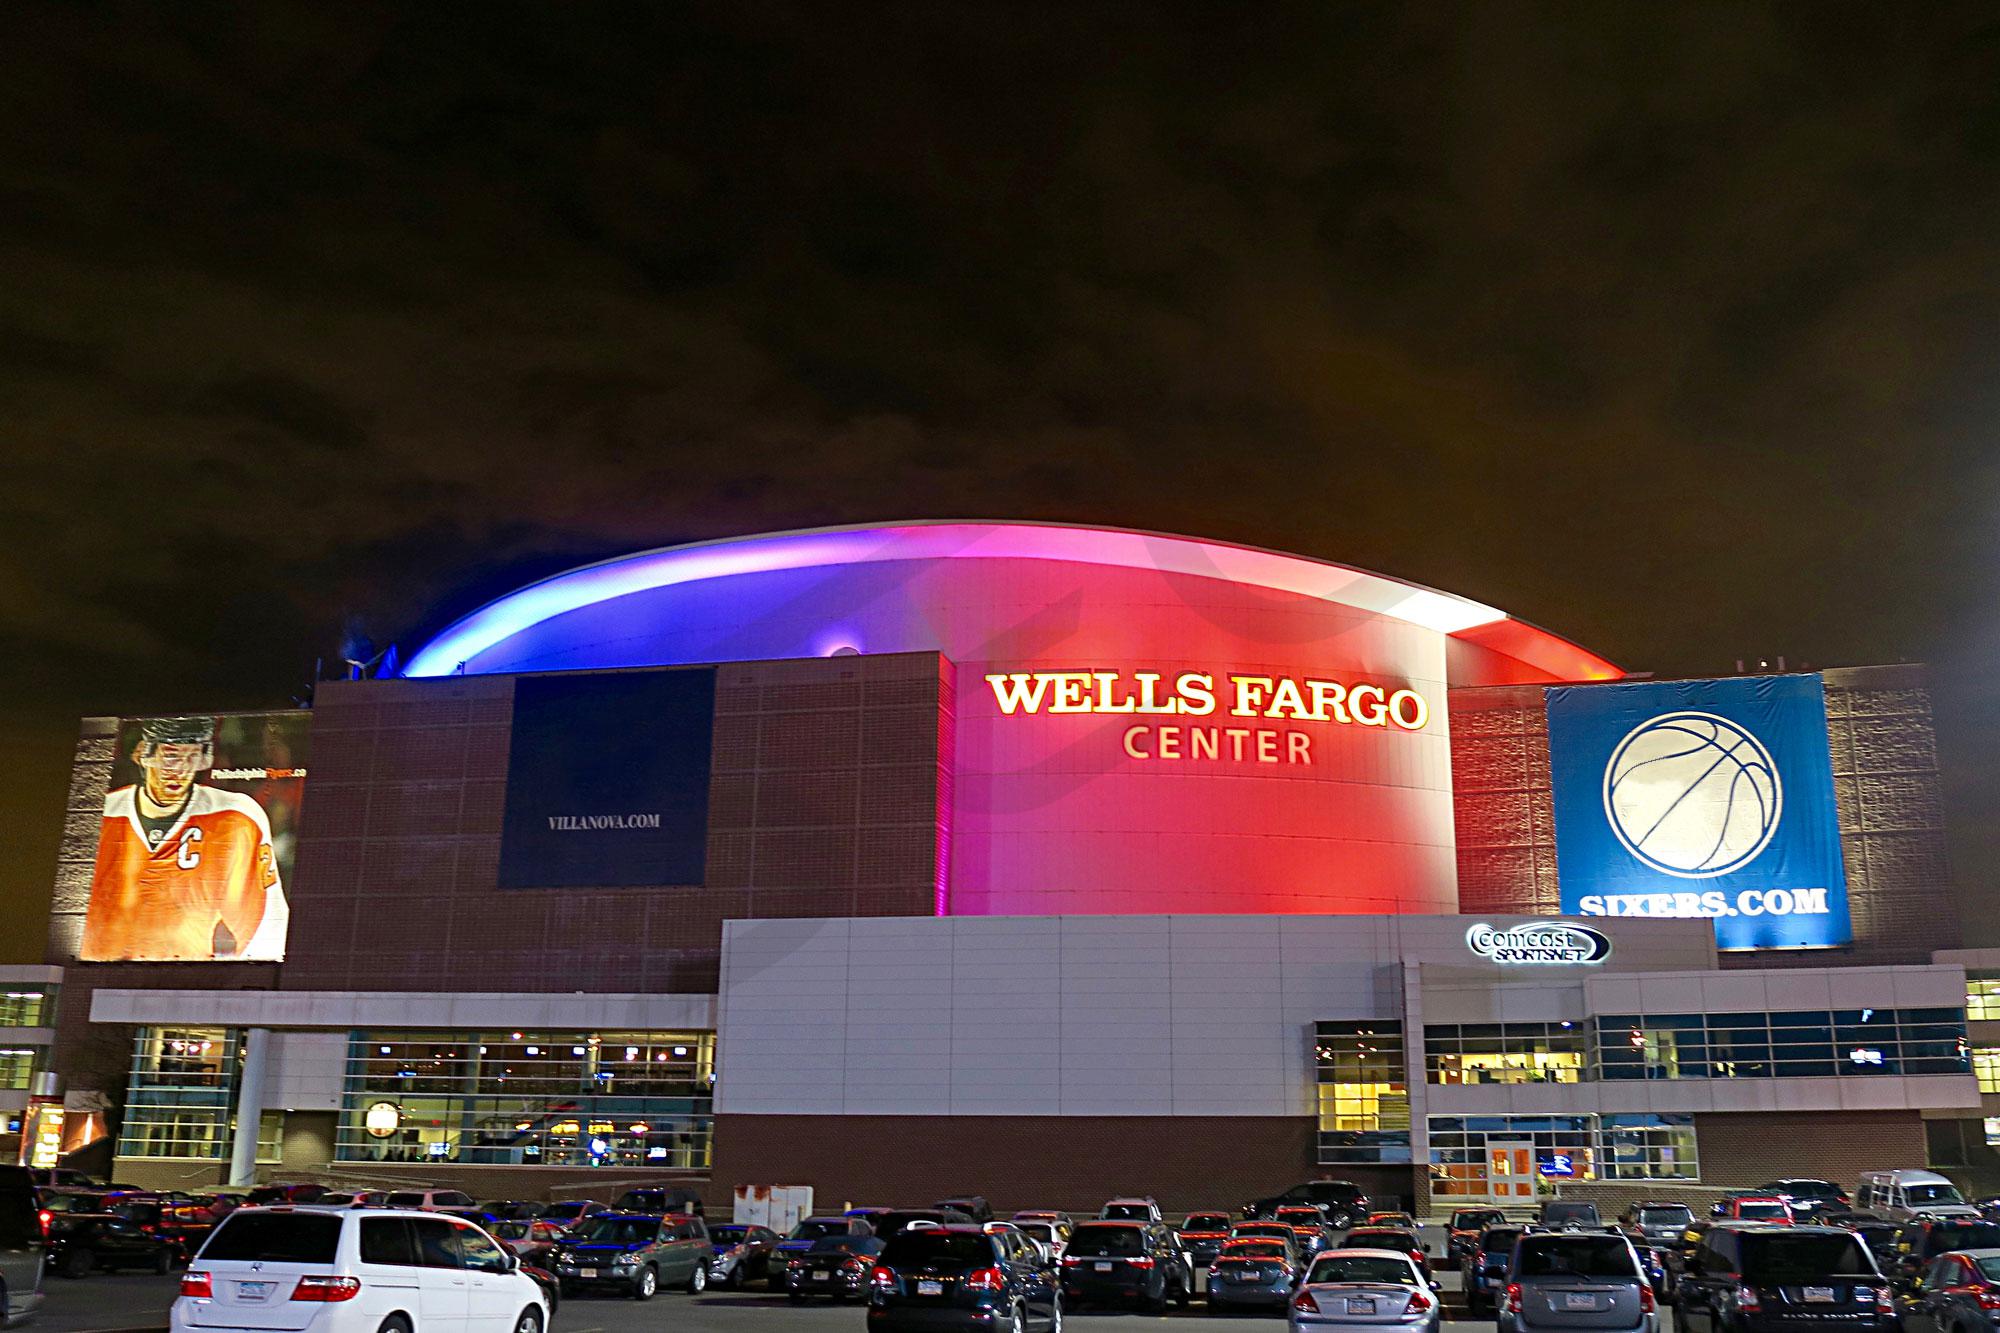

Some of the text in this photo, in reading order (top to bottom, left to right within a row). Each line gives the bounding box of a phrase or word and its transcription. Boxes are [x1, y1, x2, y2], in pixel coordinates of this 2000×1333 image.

[985, 672, 1430, 730] WELLS FARGO
[1123, 726, 1312, 765] CENTER
[548, 814, 661, 830] VILLANOVA.COM
[177, 826, 203, 870] C
[1579, 888, 1829, 918] SIXERS.COM
[1495, 948, 1586, 961] SPORTSNET
